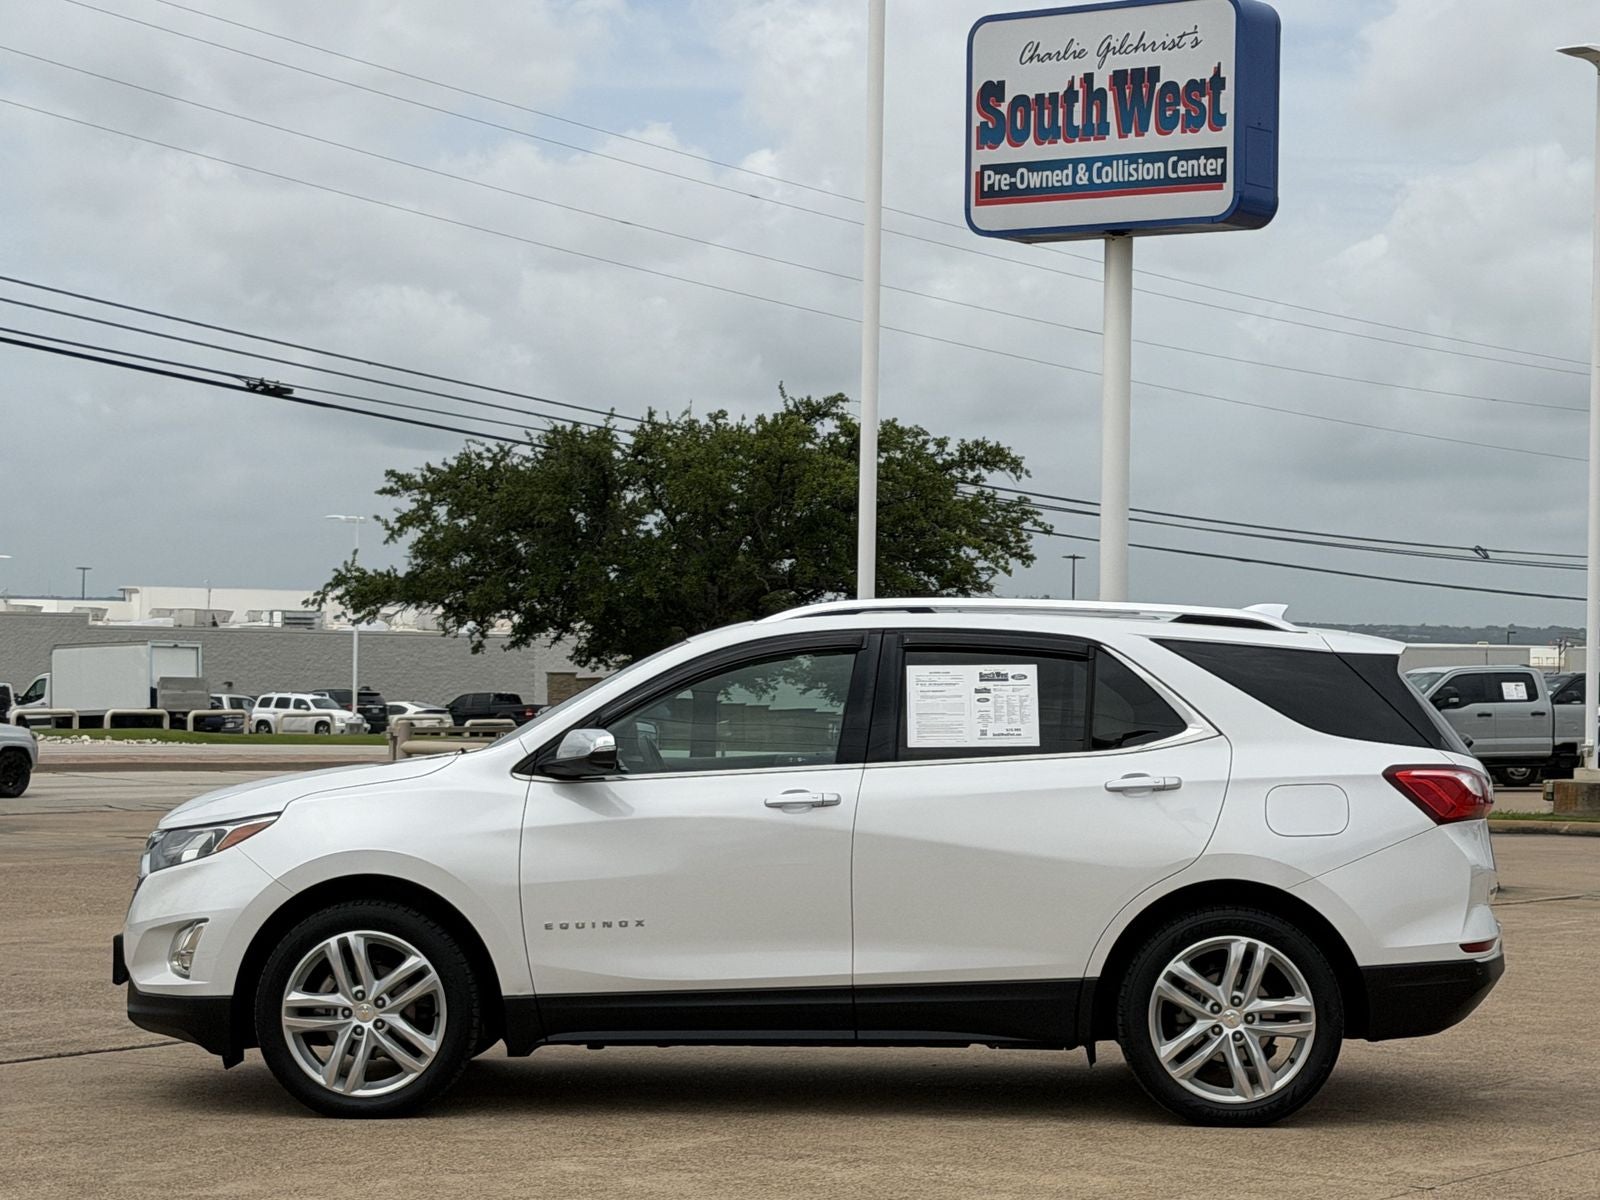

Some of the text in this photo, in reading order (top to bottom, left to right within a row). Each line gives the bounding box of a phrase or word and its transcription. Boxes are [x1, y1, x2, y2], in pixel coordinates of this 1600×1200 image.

[1019, 25, 1203, 70] Charlie Gilchrist's
[983, 155, 1225, 192] Pre-Owned & Collision Center
[544, 919, 645, 931] EQUINOX
